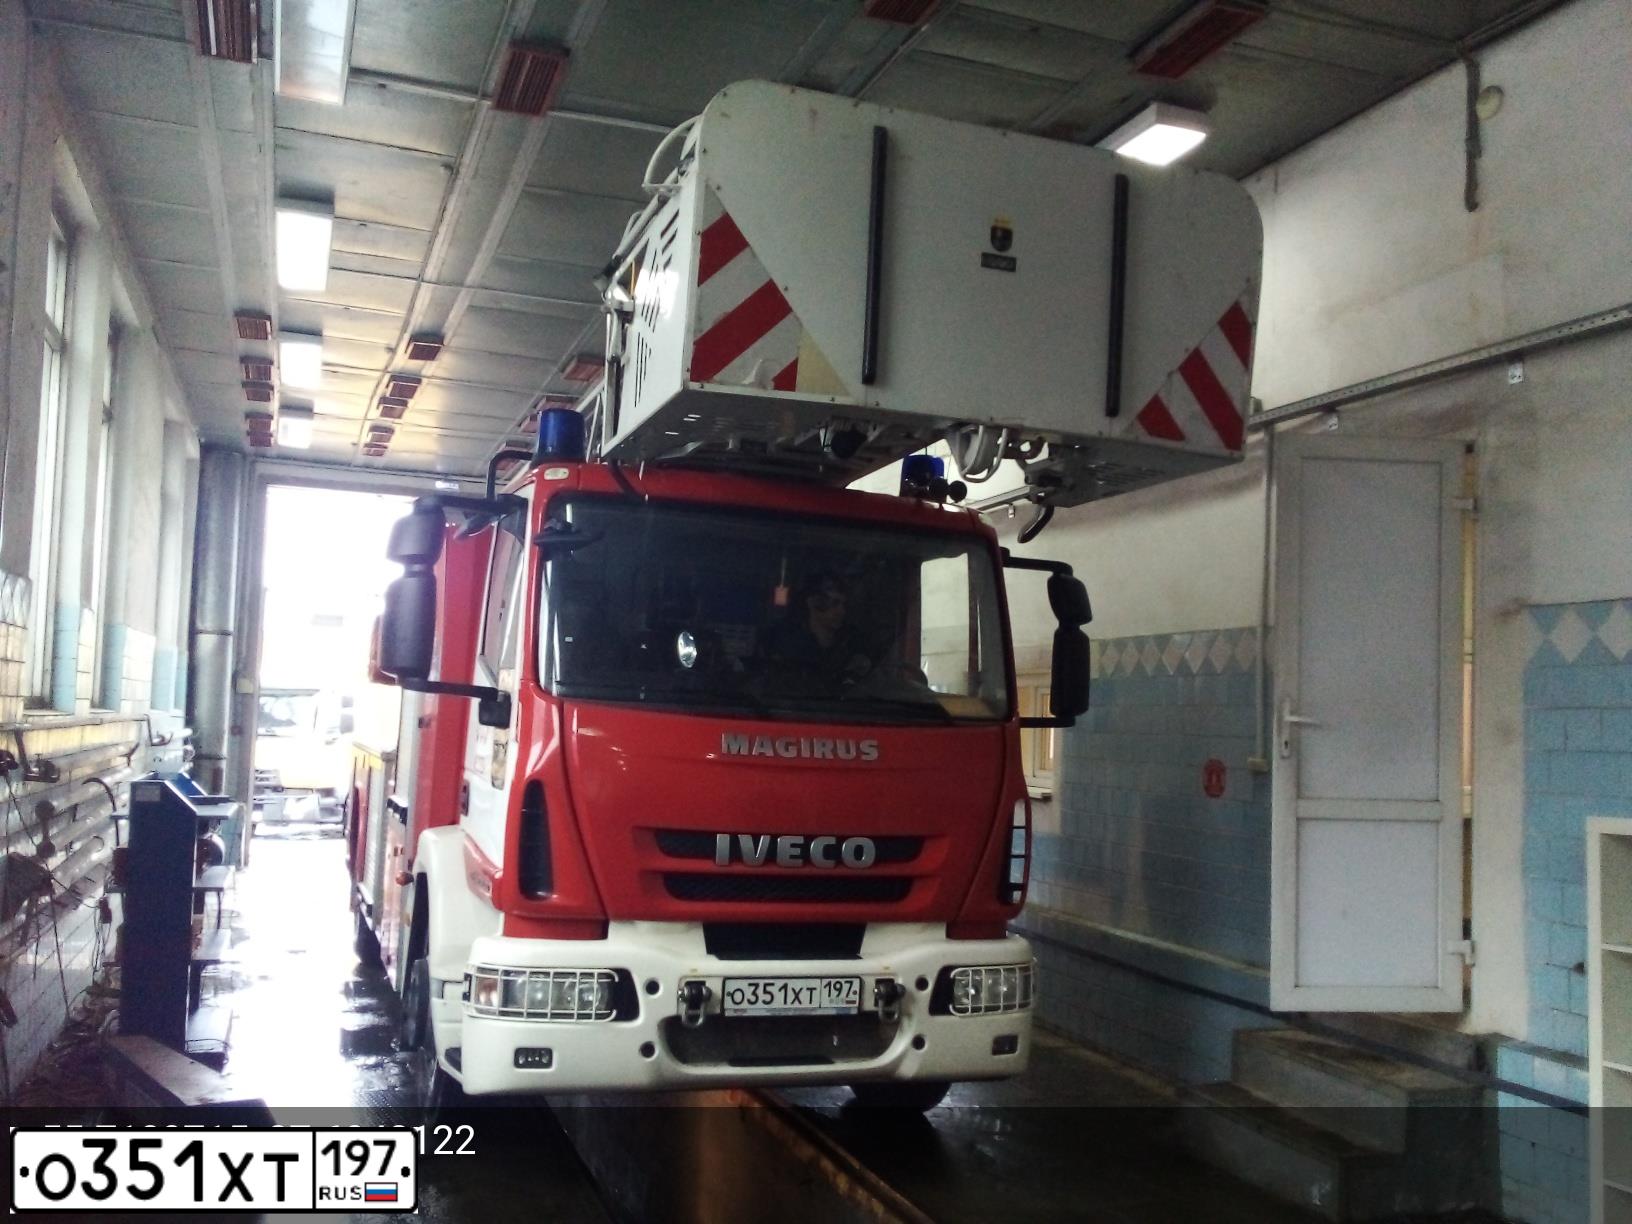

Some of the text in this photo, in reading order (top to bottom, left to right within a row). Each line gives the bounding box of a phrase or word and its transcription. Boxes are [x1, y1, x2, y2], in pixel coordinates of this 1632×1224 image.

[721, 733, 879, 761] MAGIRUS
[715, 833, 877, 869] IVECO
[823, 980, 853, 998] 197
